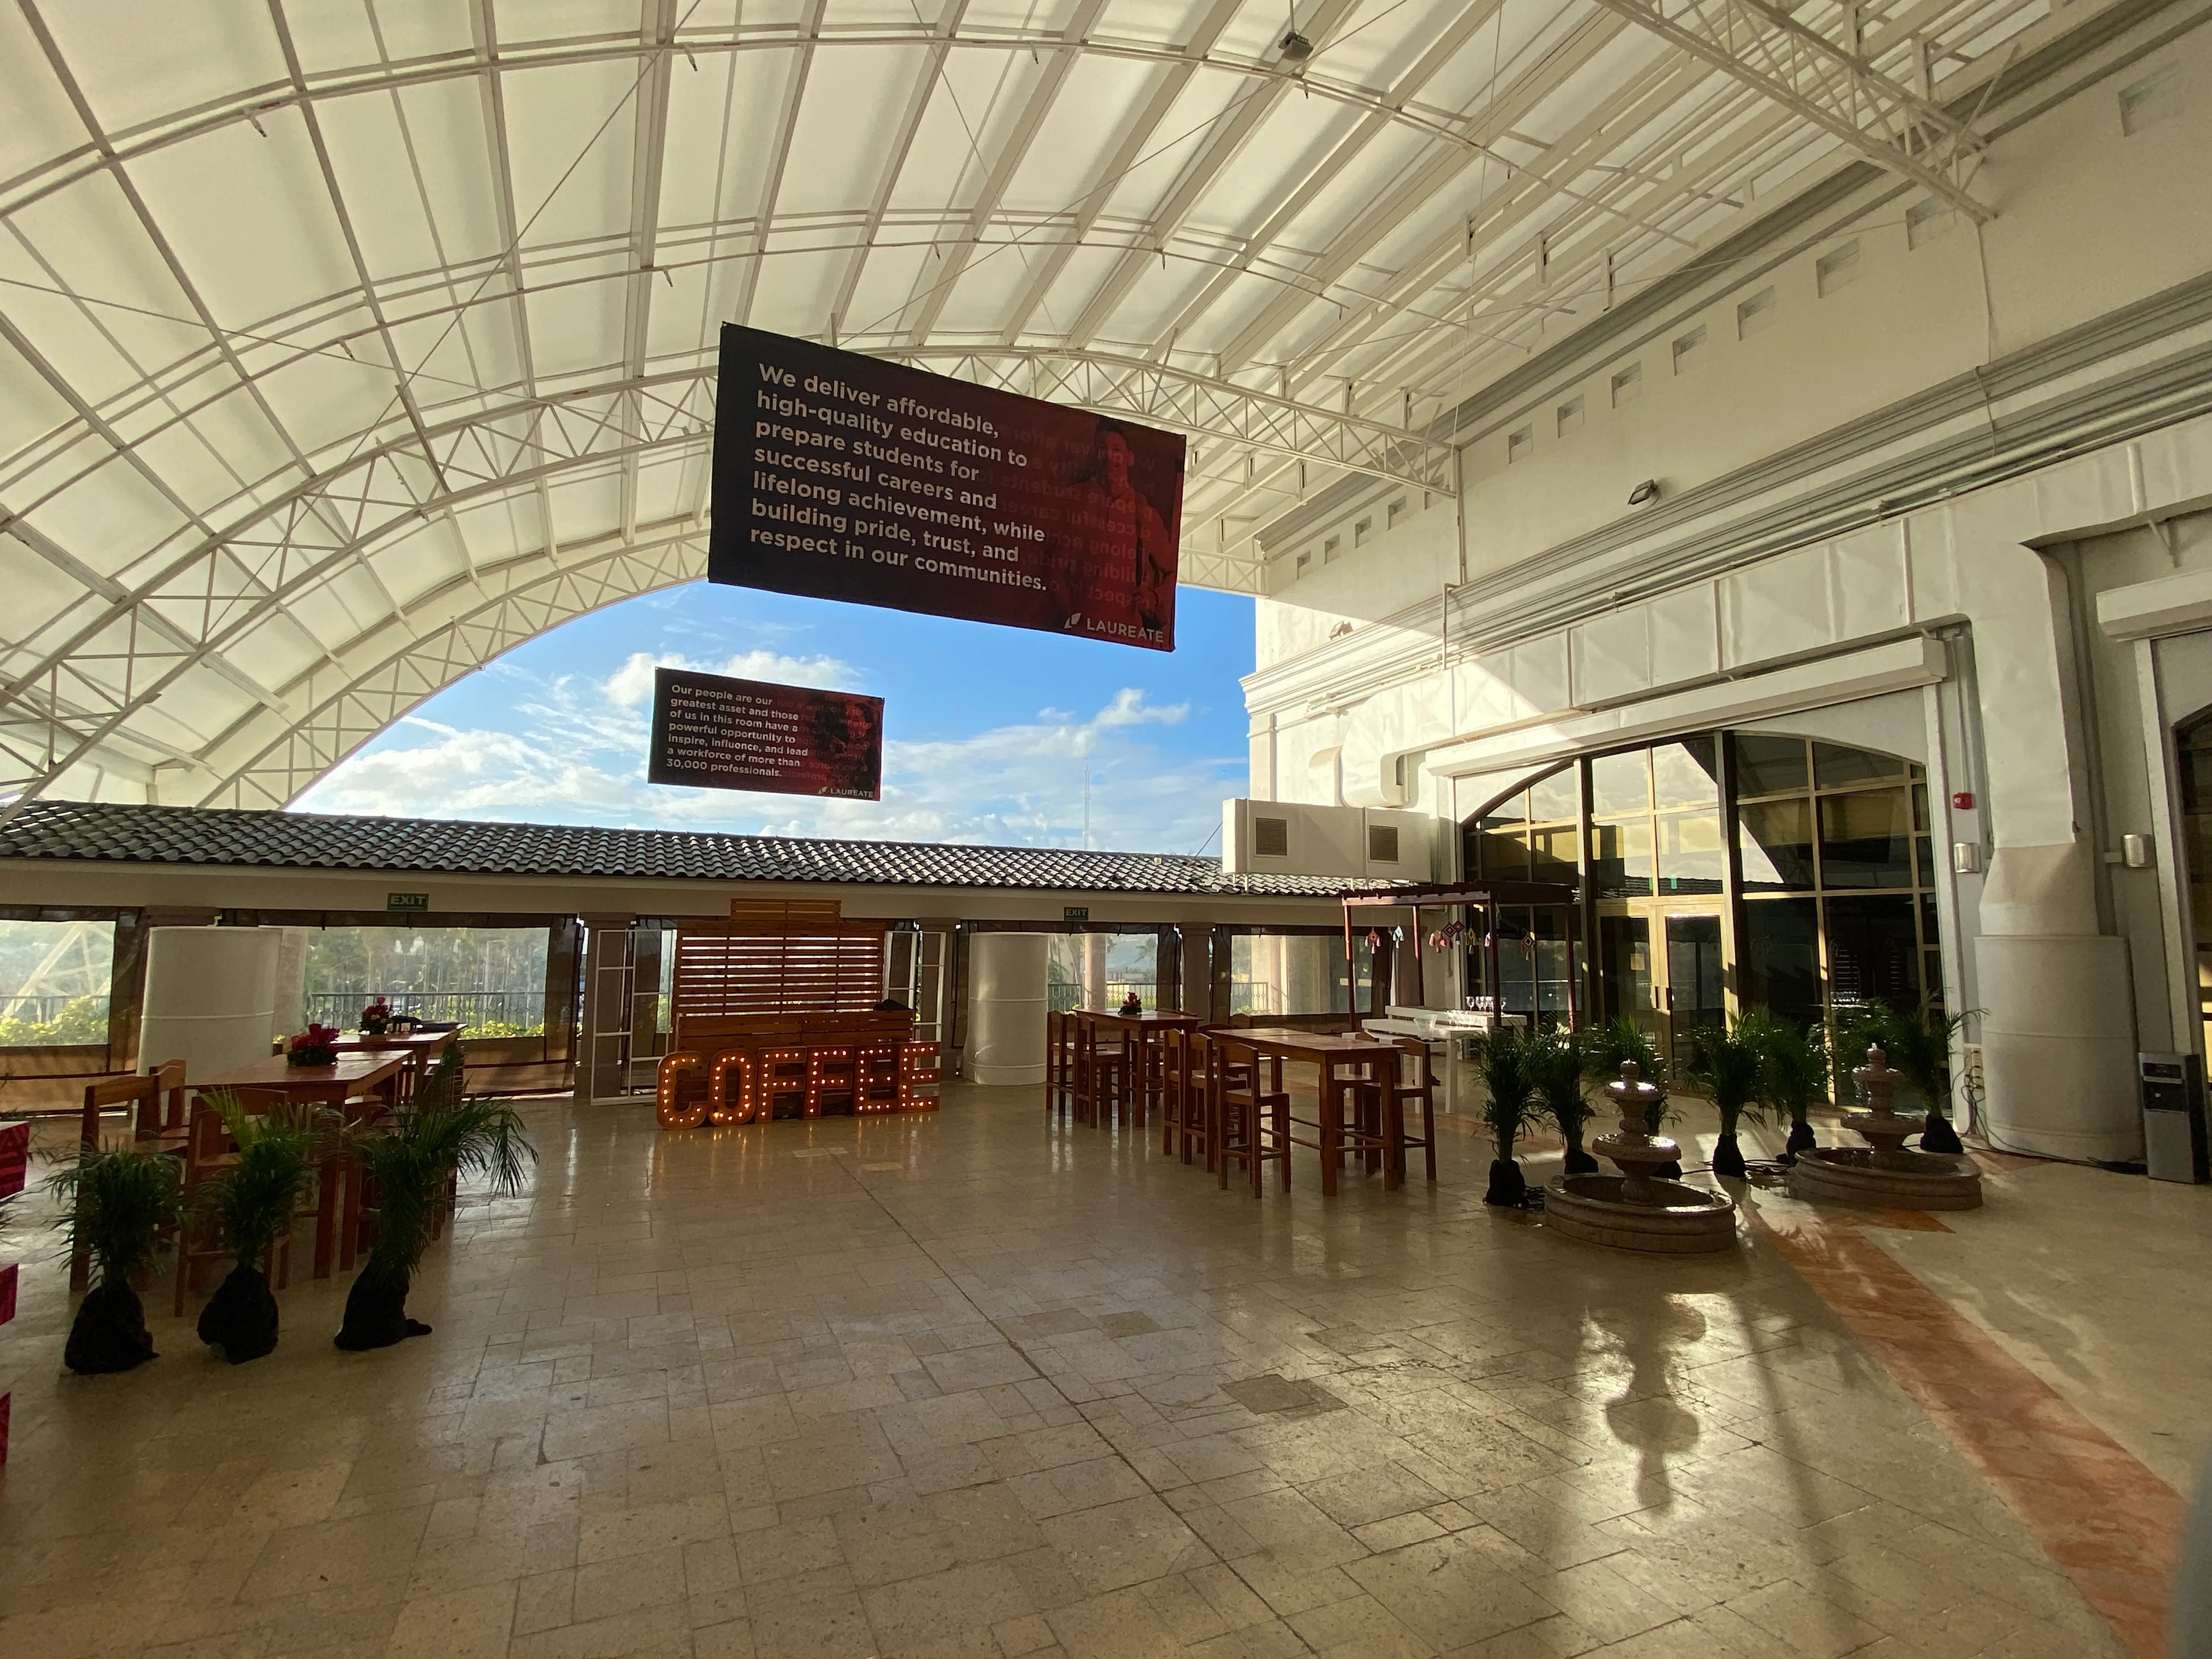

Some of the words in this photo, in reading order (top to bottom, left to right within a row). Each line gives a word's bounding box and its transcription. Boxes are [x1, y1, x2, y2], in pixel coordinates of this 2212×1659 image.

[758, 362, 797, 388] We
[803, 375, 881, 408] deliver
[886, 396, 999, 439] affordable,
[757, 389, 894, 439] high-quality
[900, 427, 1002, 462] education
[1007, 448, 1028, 467] to
[755, 420, 846, 452] prepare
[852, 440, 944, 474] students
[950, 460, 980, 482] for
[754, 448, 871, 483] successful
[877, 472, 954, 501] careers
[959, 490, 997, 510] and
[753, 470, 842, 506] lifelong
[848, 492, 987, 536] achievement,
[992, 521, 1046, 543] while
[752, 497, 848, 534] building
[854, 519, 917, 547] pride,
[922, 530, 976, 558] trust,
[982, 544, 1019, 563] and
[750, 528, 838, 556] respect
[844, 539, 865, 560] in
[871, 549, 909, 567] our
[914, 556, 1047, 591] communities.
[1086, 617, 1164, 644] LAUREATE
[672, 684, 693, 695] Our
[695, 689, 733, 701] people
[735, 695, 753, 703] are
[755, 697, 773, 706] our
[669, 709, 682, 719] of
[684, 712, 697, 720] us
[700, 712, 710, 721] in
[713, 714, 732, 724] this
[735, 718, 763, 728] room
[765, 720, 789, 731] have
[670, 698, 716, 710] greatest
[719, 704, 747, 714] asset
[748, 708, 769, 717] and
[771, 709, 799, 721] those
[668, 733, 708, 747] inspire,
[712, 737, 762, 753] influence,
[764, 746, 784, 754] and
[786, 746, 808, 757] lead
[669, 723, 718, 735] powerful
[720, 729, 782, 743] opportunity
[784, 735, 796, 743] to
[666, 758, 708, 770] 30,000
[710, 764, 782, 777] professionals.
[677, 748, 732, 760] workforce
[734, 753, 747, 761] of
[748, 755, 775, 765] more
[777, 757, 800, 767] than
[830, 787, 874, 798] LAUREATE
[391, 895, 425, 905] EXIT
[656, 1041, 940, 1130] COFFEE
